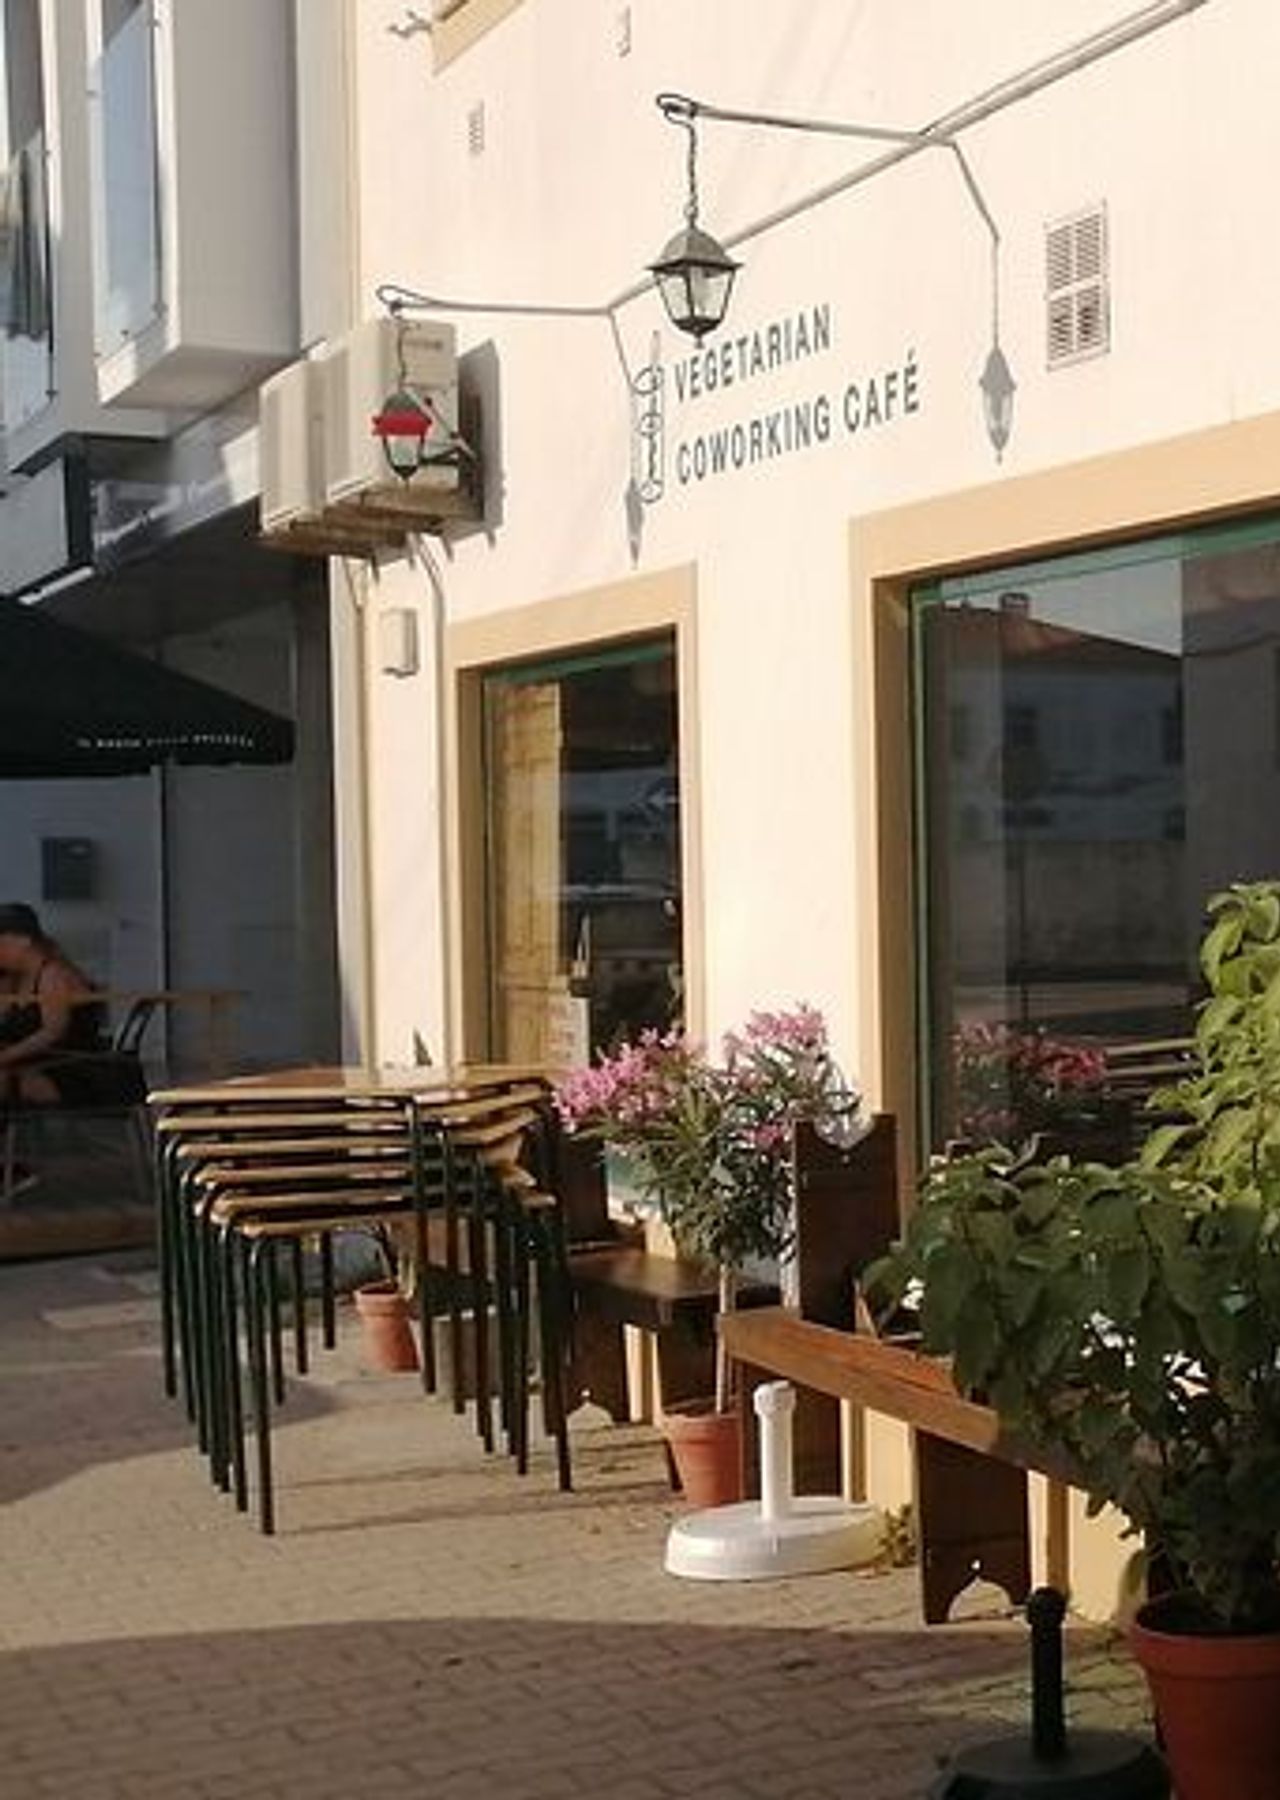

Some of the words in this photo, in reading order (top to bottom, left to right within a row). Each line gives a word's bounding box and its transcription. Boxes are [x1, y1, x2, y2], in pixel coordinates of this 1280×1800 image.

[674, 303, 831, 402] VEGETARIAN
[676, 395, 831, 485] COWORKING
[843, 347, 920, 433] CAFÉ
